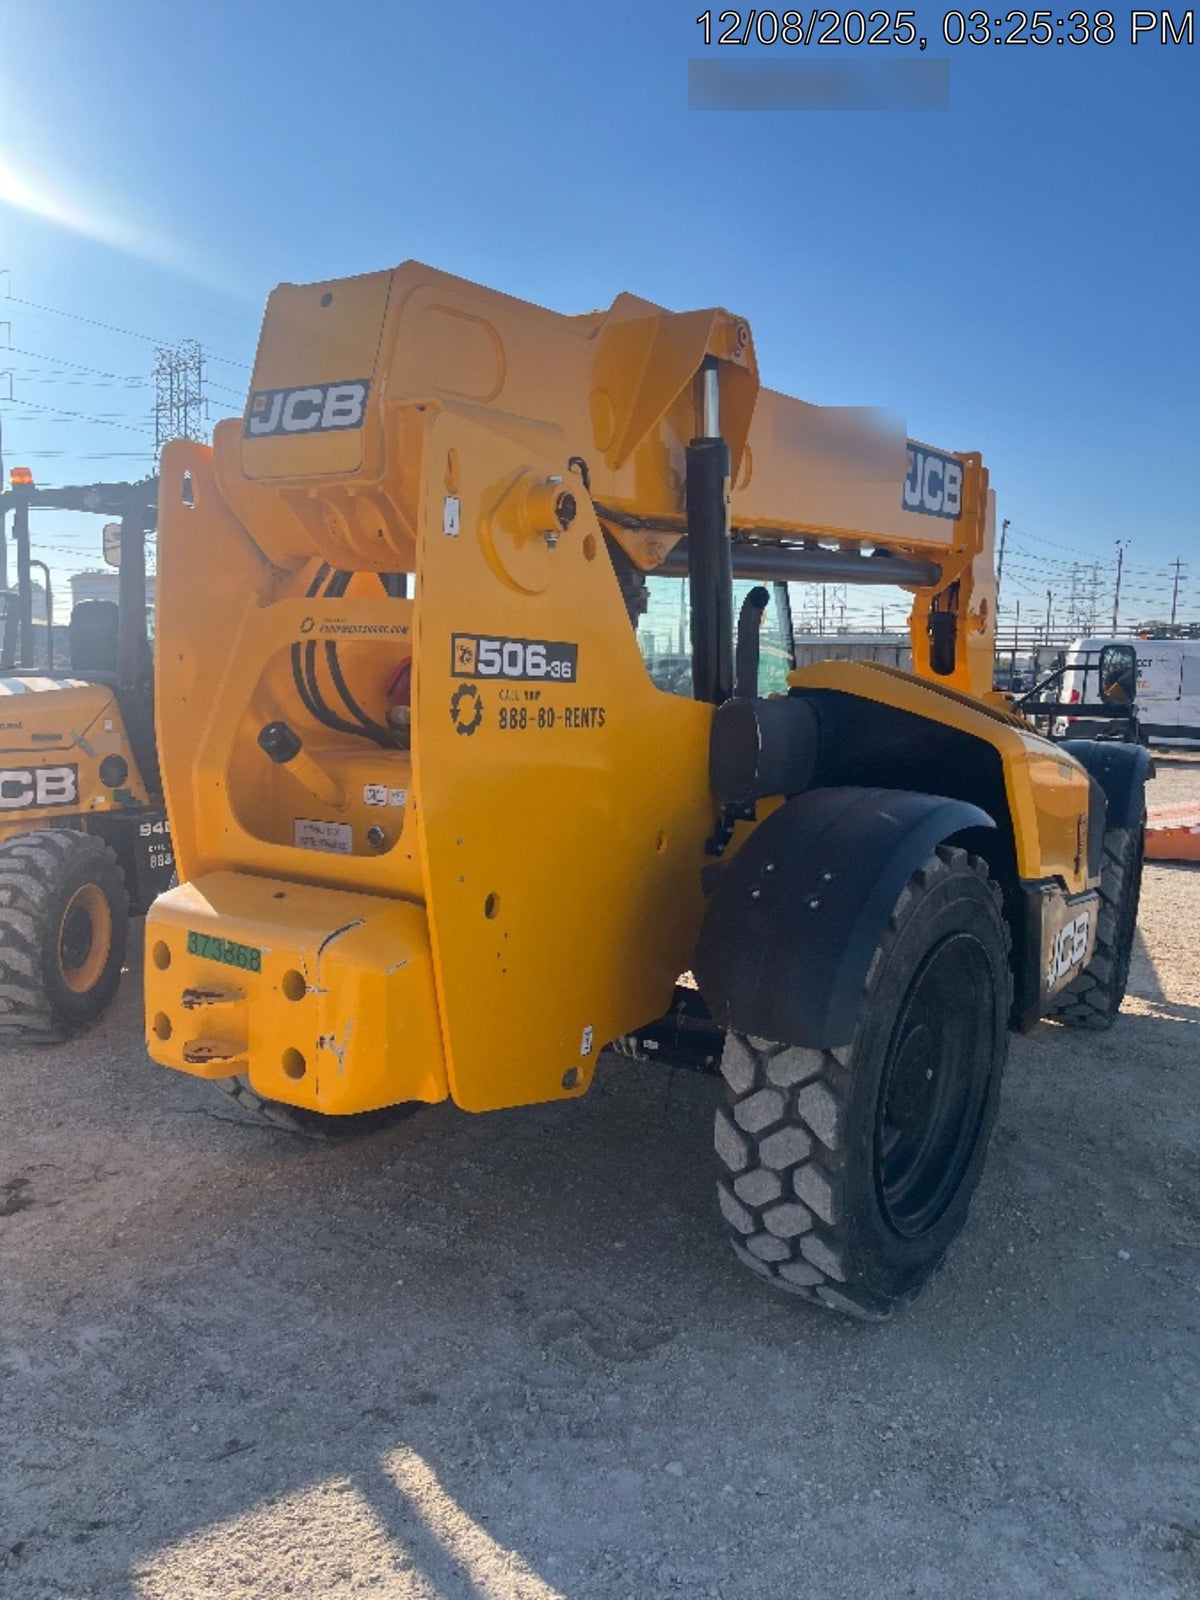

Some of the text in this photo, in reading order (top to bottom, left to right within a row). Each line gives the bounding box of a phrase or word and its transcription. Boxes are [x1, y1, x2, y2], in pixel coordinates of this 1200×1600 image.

[250, 385, 365, 434] JCB
[904, 453, 962, 514] JCB
[478, 640, 572, 678] 506-36
[499, 706, 606, 730] 888-80-RENTS
[188, 931, 262, 974] 373868
[1047, 911, 1089, 992] JCB
